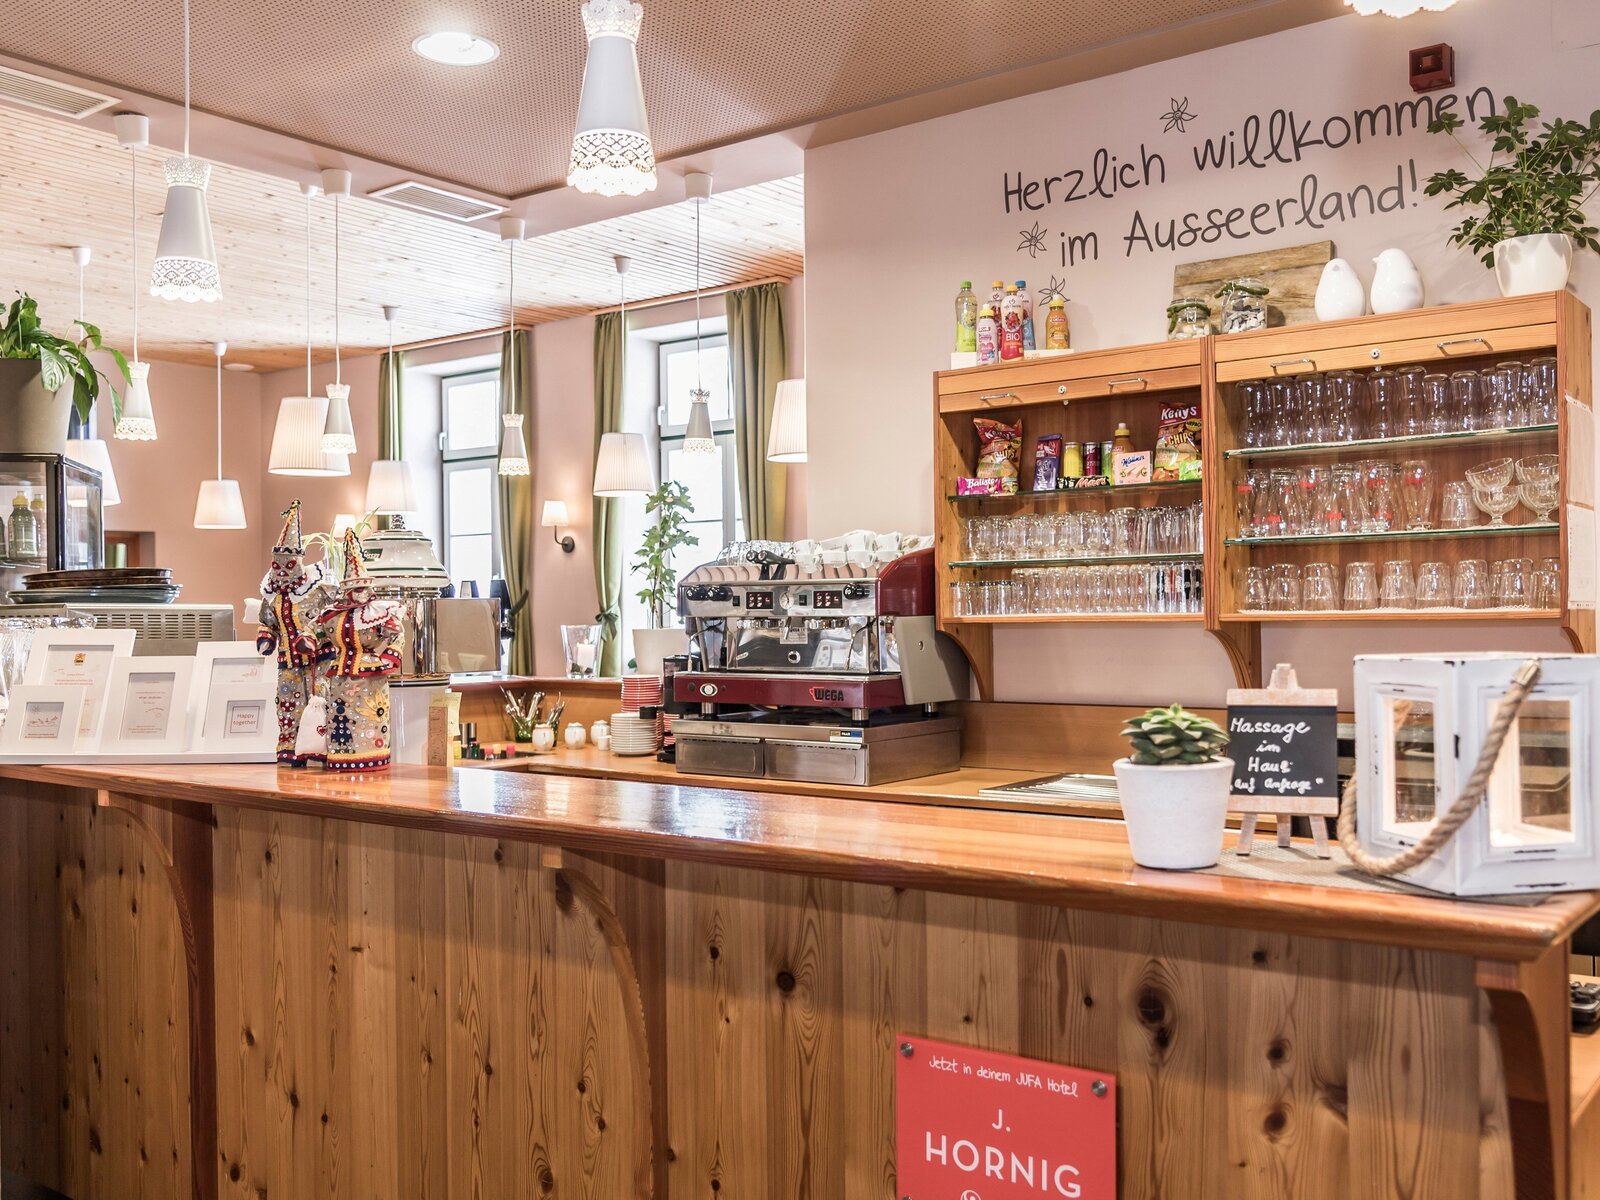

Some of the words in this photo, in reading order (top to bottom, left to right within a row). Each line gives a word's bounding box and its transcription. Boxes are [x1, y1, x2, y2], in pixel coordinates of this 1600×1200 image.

[1004, 143, 1166, 214] Herzlich
[1193, 86, 1497, 170] willkommen
[1060, 231, 1098, 267] im
[1123, 158, 1420, 258] Ausseerland!
[1006, 332, 1021, 341] BIO
[1168, 432, 1194, 445] CHIPS
[965, 478, 998, 489] Balisto
[814, 688, 844, 702] WEGA
[232, 719, 257, 727] together
[1230, 717, 1311, 743] Massage
[1256, 740, 1281, 753] im
[1247, 756, 1292, 773] Haus
[929, 1055, 958, 1073] Jetzt
[963, 1063, 972, 1075] in
[977, 1066, 1011, 1083] deinem
[1016, 1072, 1043, 1089] JUFA
[1047, 1077, 1079, 1098] Hotel
[992, 1109, 1011, 1132] J.
[925, 1131, 1082, 1198] HORNIG
